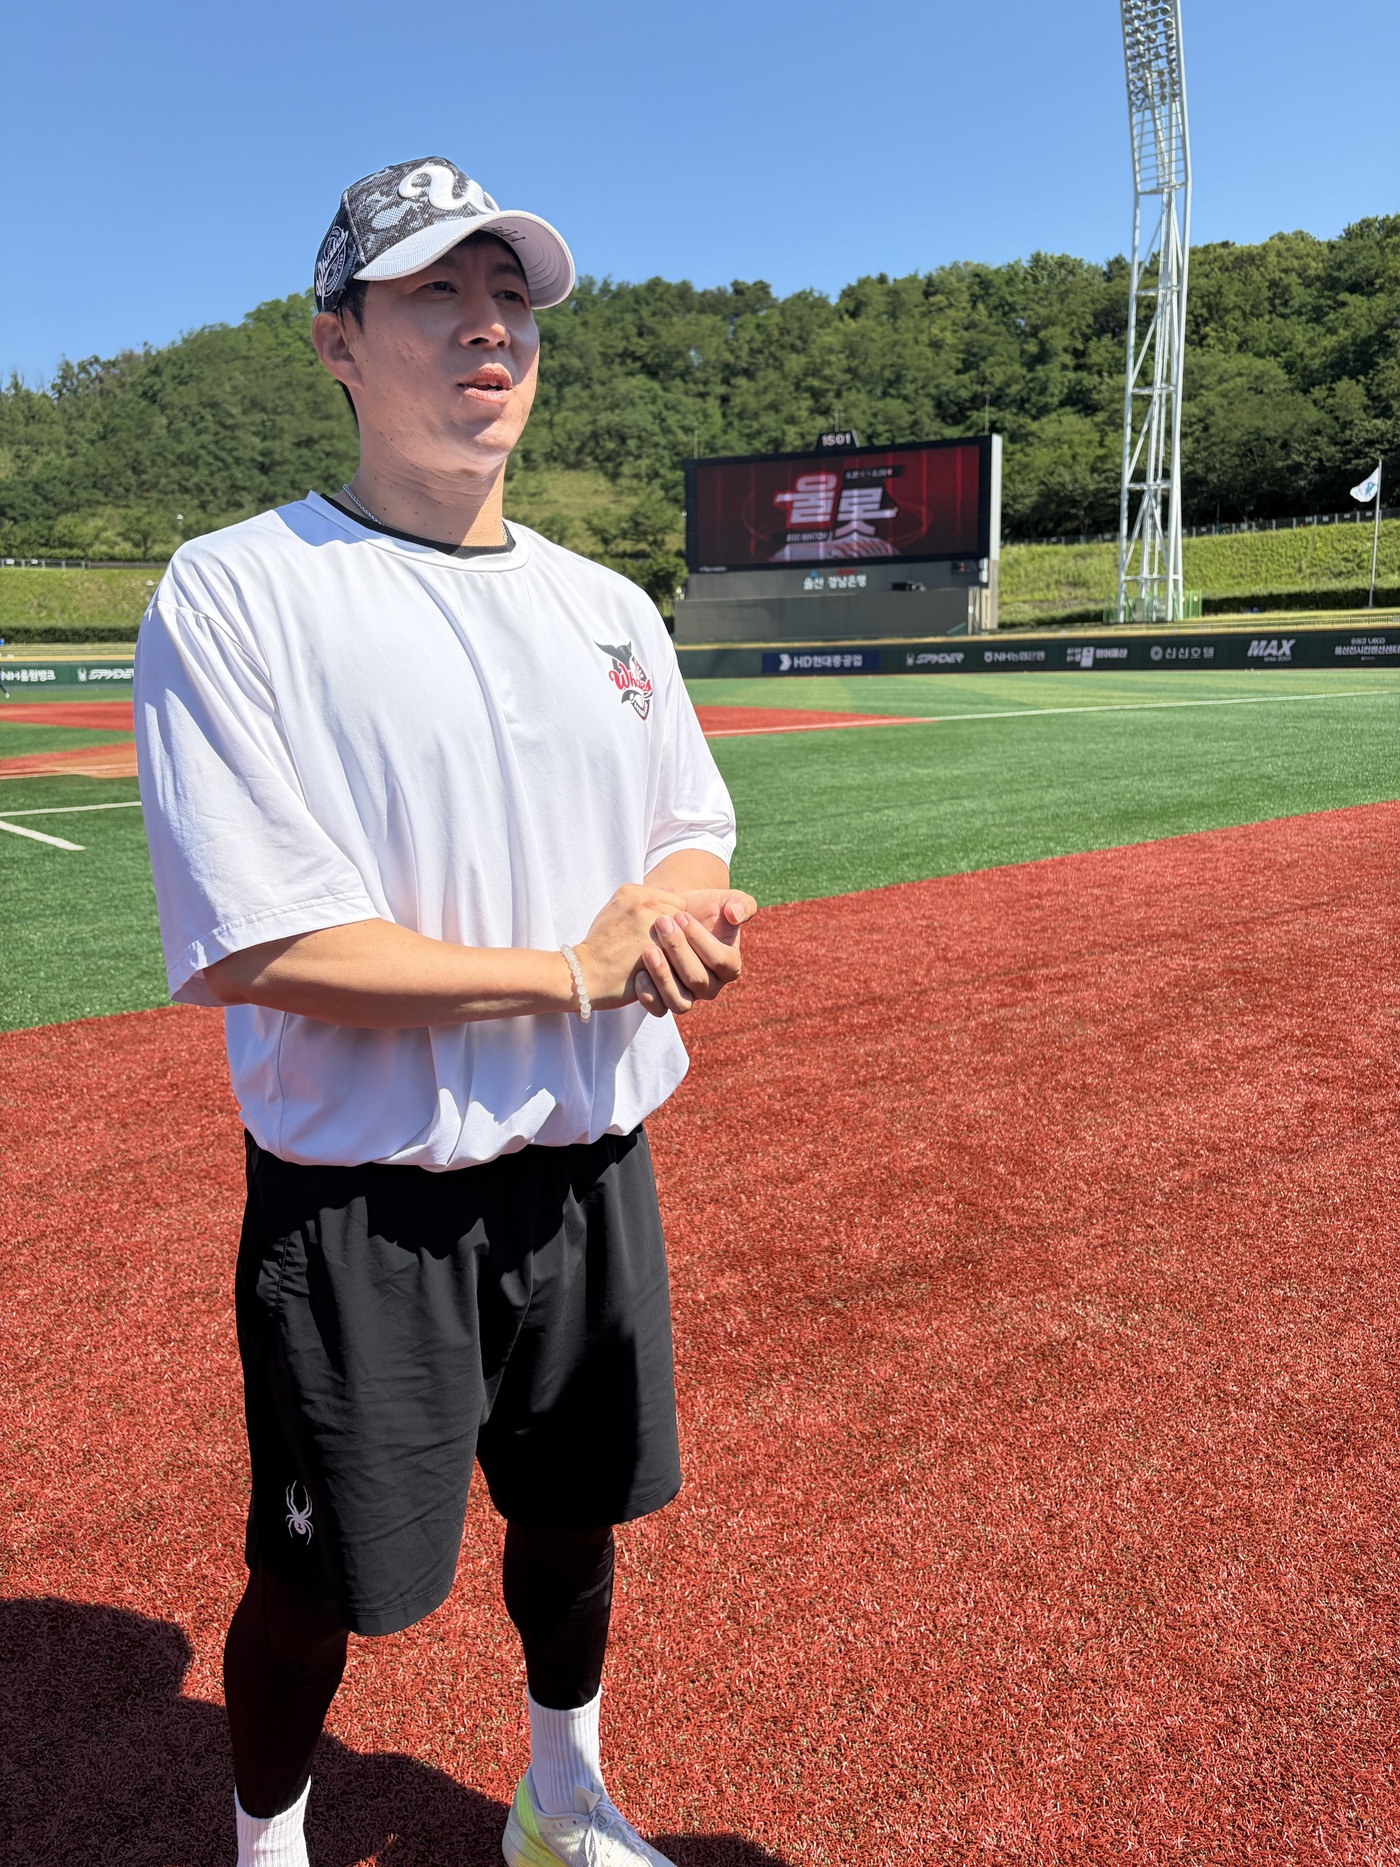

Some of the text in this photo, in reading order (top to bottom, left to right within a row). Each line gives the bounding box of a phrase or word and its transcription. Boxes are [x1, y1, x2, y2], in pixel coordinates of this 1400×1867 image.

[1165, 646, 1214, 659] 신신호텔
[1247, 639, 1296, 657] MAX
[915, 652, 965, 664] SPYDER
[89, 668, 134, 680] SPYDE
